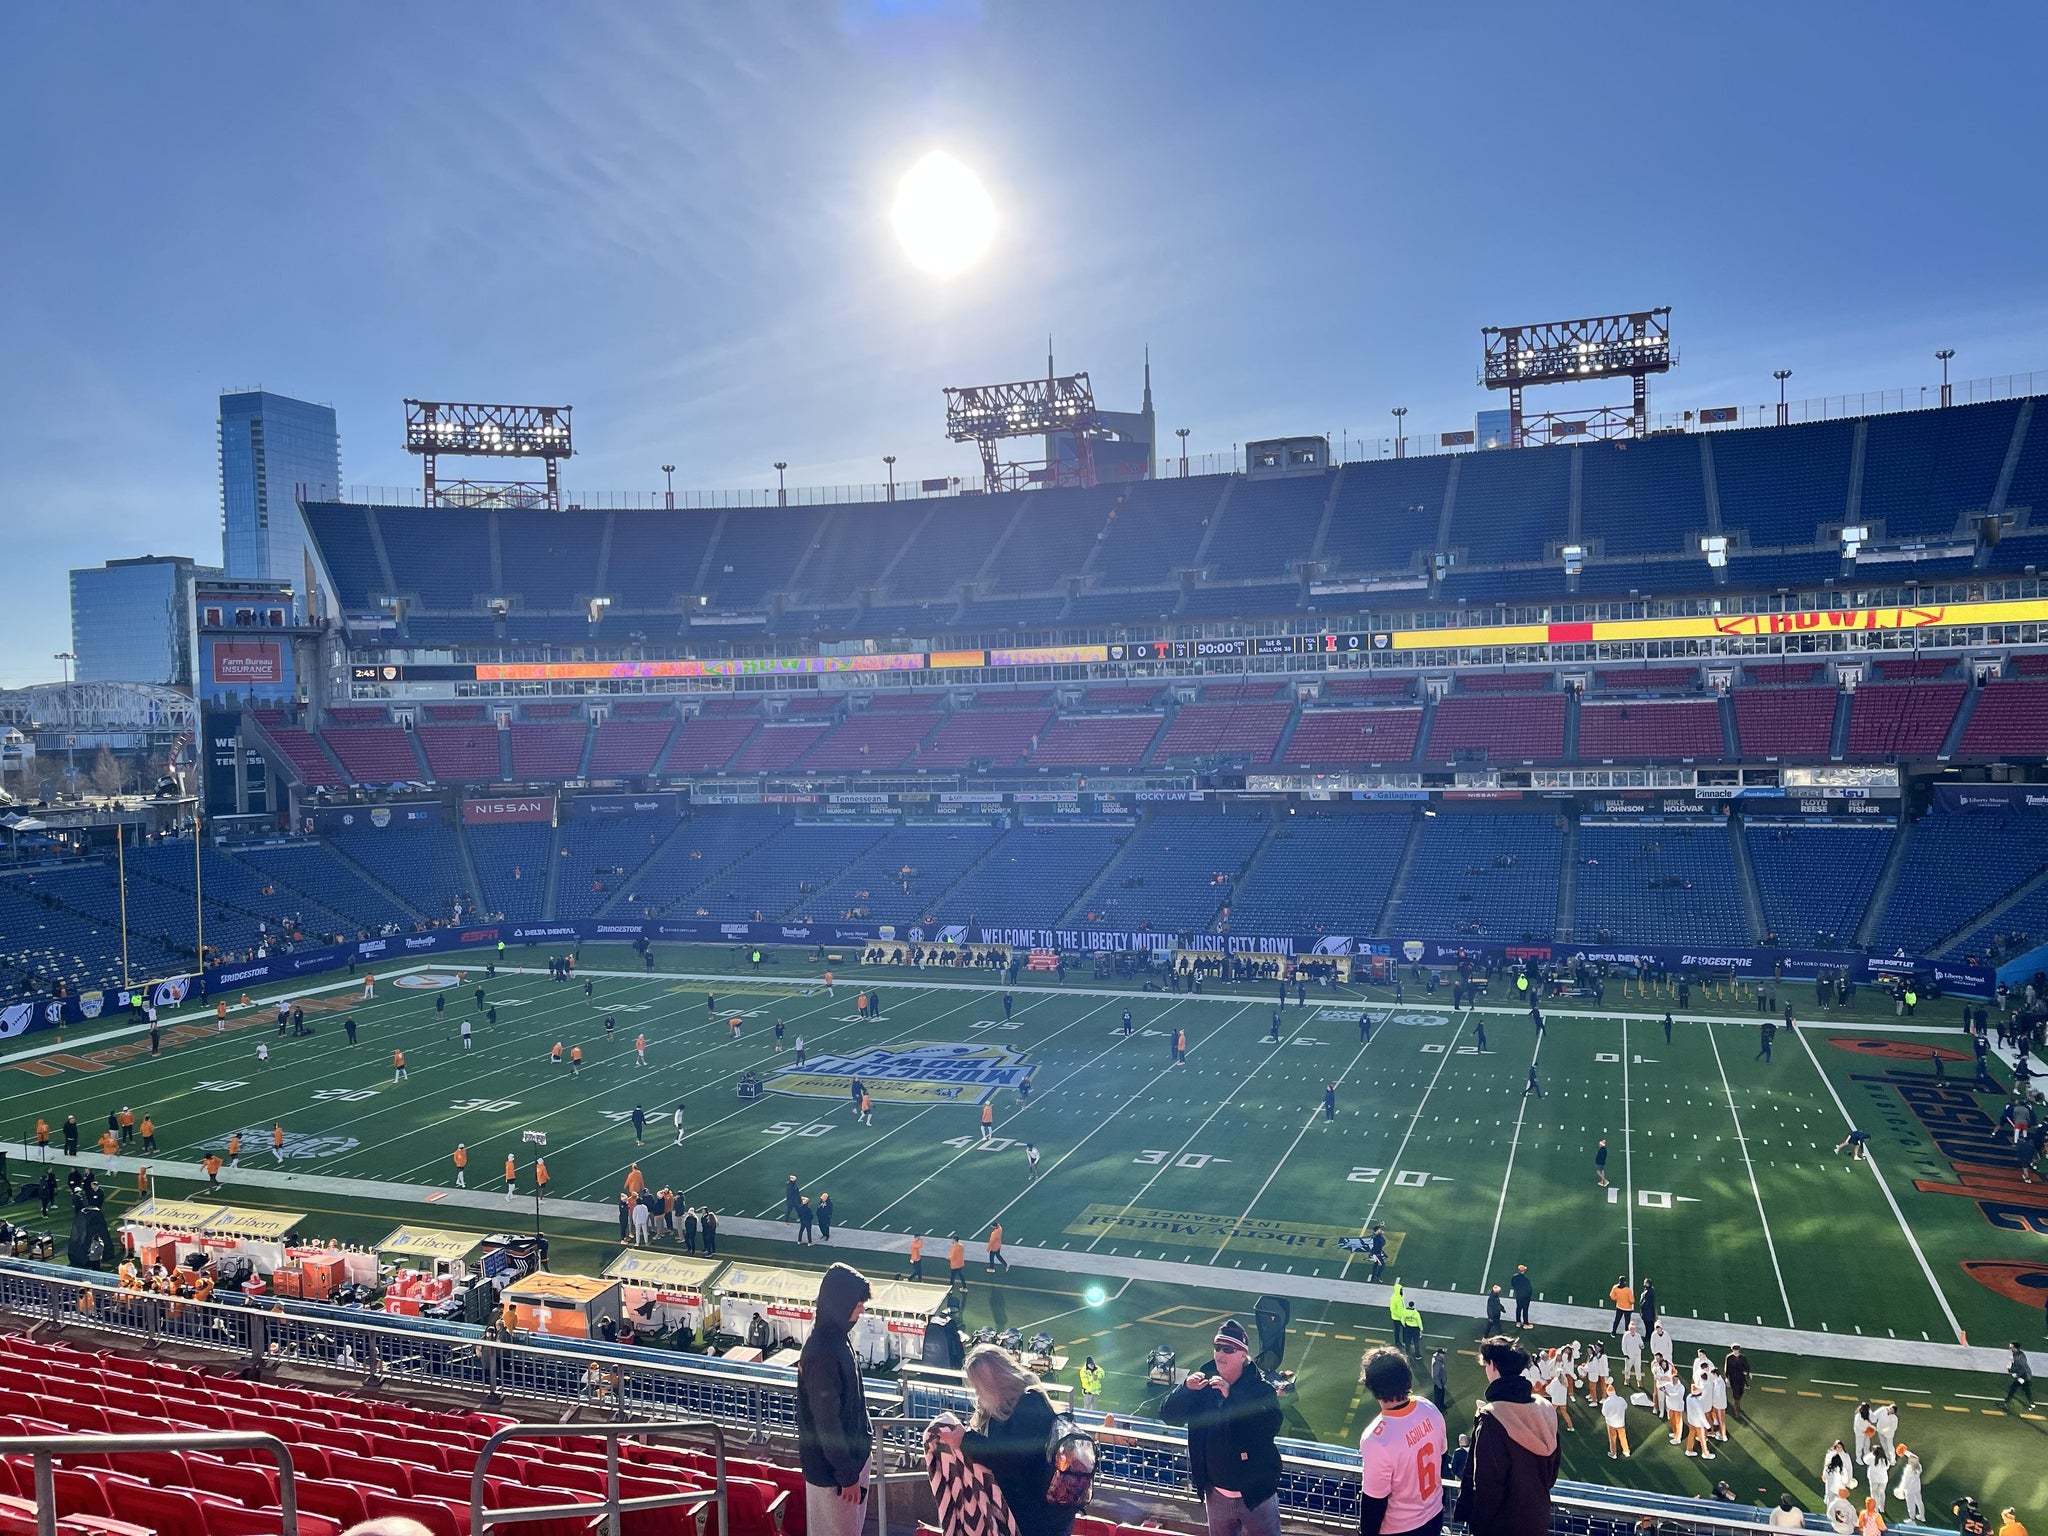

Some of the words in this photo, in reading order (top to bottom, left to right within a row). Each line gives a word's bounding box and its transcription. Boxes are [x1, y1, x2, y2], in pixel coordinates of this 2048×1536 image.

[1197, 643, 1233, 655] 90:00
[1307, 643, 1313, 651] 3
[1348, 636, 1359, 648] 0
[1137, 646, 1146, 657] 0
[1153, 642, 1169, 659] T
[355, 669, 375, 677] 2:45
[835, 795, 882, 803] Tennessean
[1167, 792, 1186, 800] LAW
[1377, 791, 1418, 800] Gallagher
[475, 803, 541, 814] NISSAN
[1663, 805, 1704, 813] HOLOVAK
[1848, 806, 1880, 814] FISHER
[460, 929, 499, 942] ESPN
[525, 928, 547, 936] DELTA
[547, 927, 576, 935] DENTAL
[597, 925, 643, 933] BRIDGESTONE
[981, 928, 1036, 947] WELCOME
[1038, 930, 1053, 948] TO
[1055, 930, 1078, 949] THE
[1081, 931, 1128, 950] LIBERTY
[1228, 936, 1256, 955] CITY
[1260, 937, 1297, 956] BOWL
[1505, 947, 1552, 960] ESPN
[1588, 952, 1616, 963] DELTA
[220, 966, 269, 984] BRIDGESTONE
[1944, 973, 1964, 981] Liberty
[1964, 974, 1985, 983] Mutual
[968, 1020, 1025, 1030] 50
[868, 1053, 988, 1069] BOWL
[885, 1067, 1019, 1085] MUSIC
[311, 1088, 382, 1102] 20
[450, 1098, 522, 1112] 30
[761, 1121, 838, 1138] 50
[942, 1135, 1017, 1152] 40
[1132, 1150, 1214, 1168] 30
[1347, 1167, 1431, 1187] 20
[1607, 1187, 1673, 1209] 10
[156, 1207, 202, 1222] Liberty
[1149, 1209, 1281, 1229] INSURANCE
[235, 1216, 282, 1232] Liberty
[1087, 1215, 1203, 1237] Mutual
[414, 1236, 463, 1253] Liberty
[1204, 1226, 1327, 1248] Liberty
[642, 1262, 697, 1279] Liberty
[532, 1308, 552, 1333] T
[1405, 1418, 1434, 1448] AGUILAR
[1416, 1442, 1437, 1502] 6
[1964, 1518, 1984, 1535] 25
